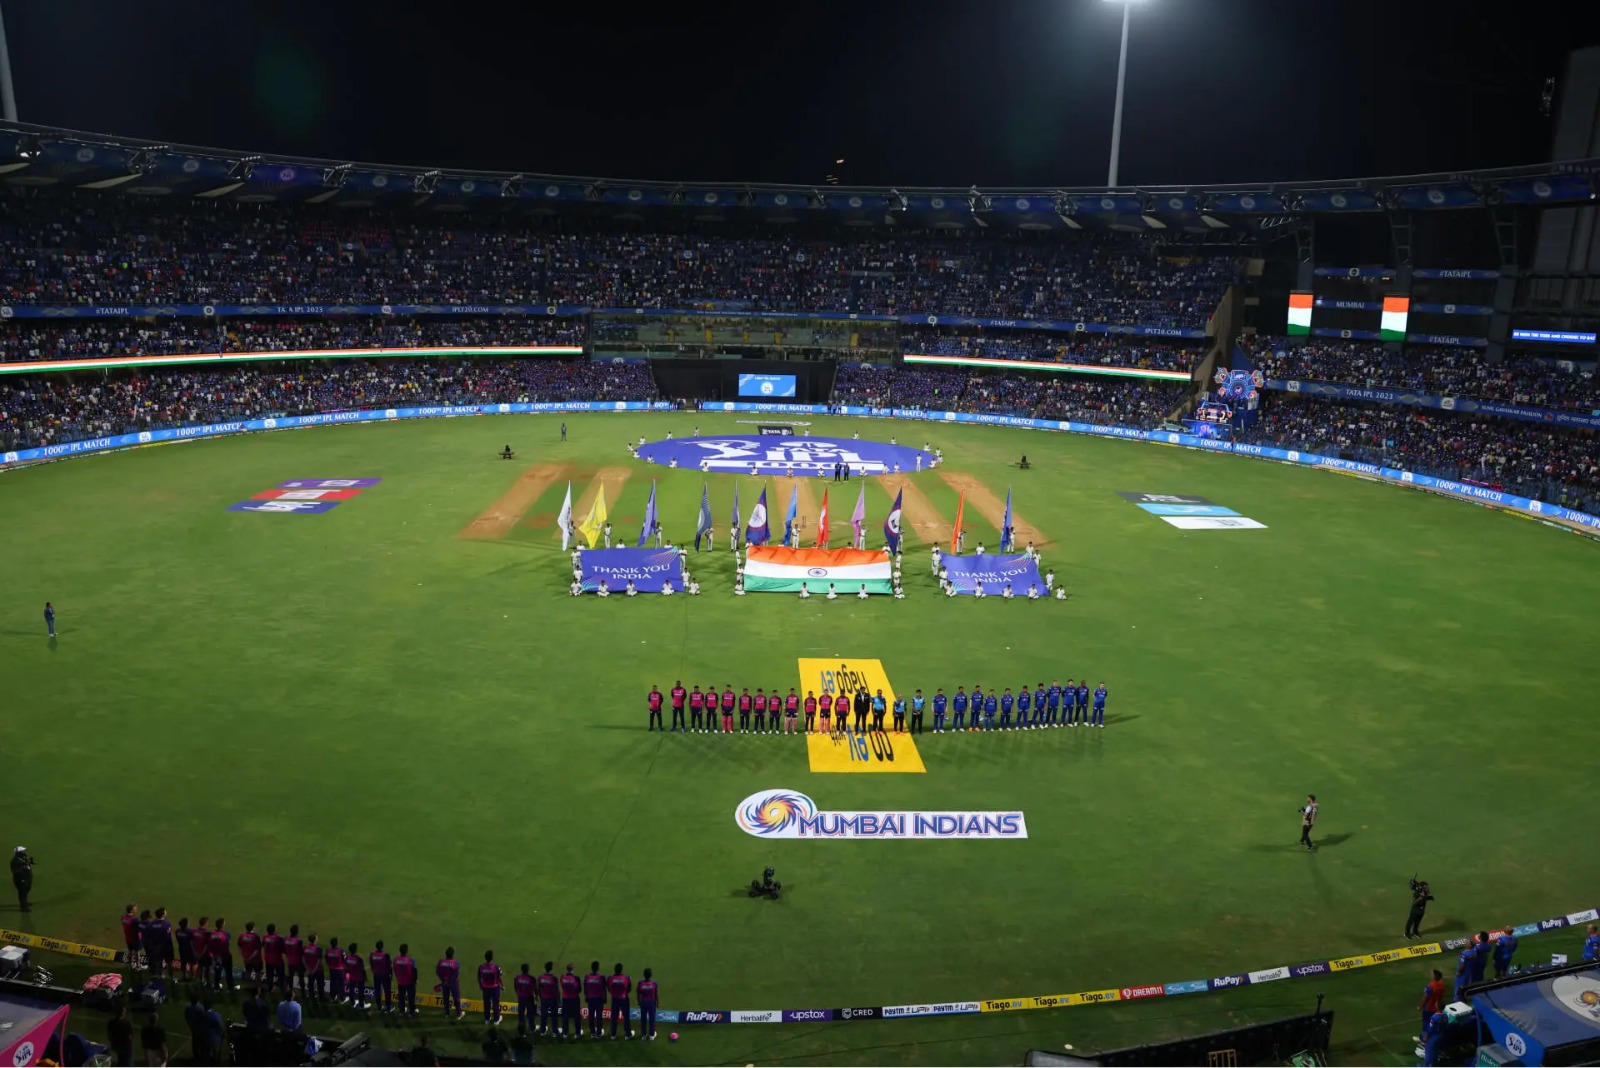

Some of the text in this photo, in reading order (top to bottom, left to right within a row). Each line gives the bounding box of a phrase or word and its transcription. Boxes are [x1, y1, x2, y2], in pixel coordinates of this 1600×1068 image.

[1346, 388, 1361, 397] TATA
[1376, 392, 1393, 400] 2023
[334, 412, 359, 420] MATCH
[1010, 417, 1034, 425] MATCH
[83, 438, 110, 449] MATCH
[1236, 443, 1261, 454] MATCH
[1474, 487, 1502, 501] MATCH
[592, 563, 670, 573] THANK YOU
[1001, 567, 1028, 576] YOU
[799, 812, 1022, 837] MUMBAI INDIANS
[1542, 919, 1562, 929] RuPay
[1408, 944, 1436, 955] Tiago.ev
[1371, 951, 1401, 962] Tiago.ev
[1297, 964, 1324, 975] upstox
[1334, 959, 1364, 969] Tiago.ev
[1214, 976, 1240, 987] RuPay
[1080, 992, 1115, 1002] Tiago.ev
[1133, 986, 1162, 997] DREAM11
[986, 1000, 1023, 1010] Tiago.ev
[1033, 996, 1069, 1006] Tiago.ev
[686, 1012, 719, 1023] RuPay
[741, 1012, 772, 1022] Herbalife
[789, 1010, 824, 1021] upstox
